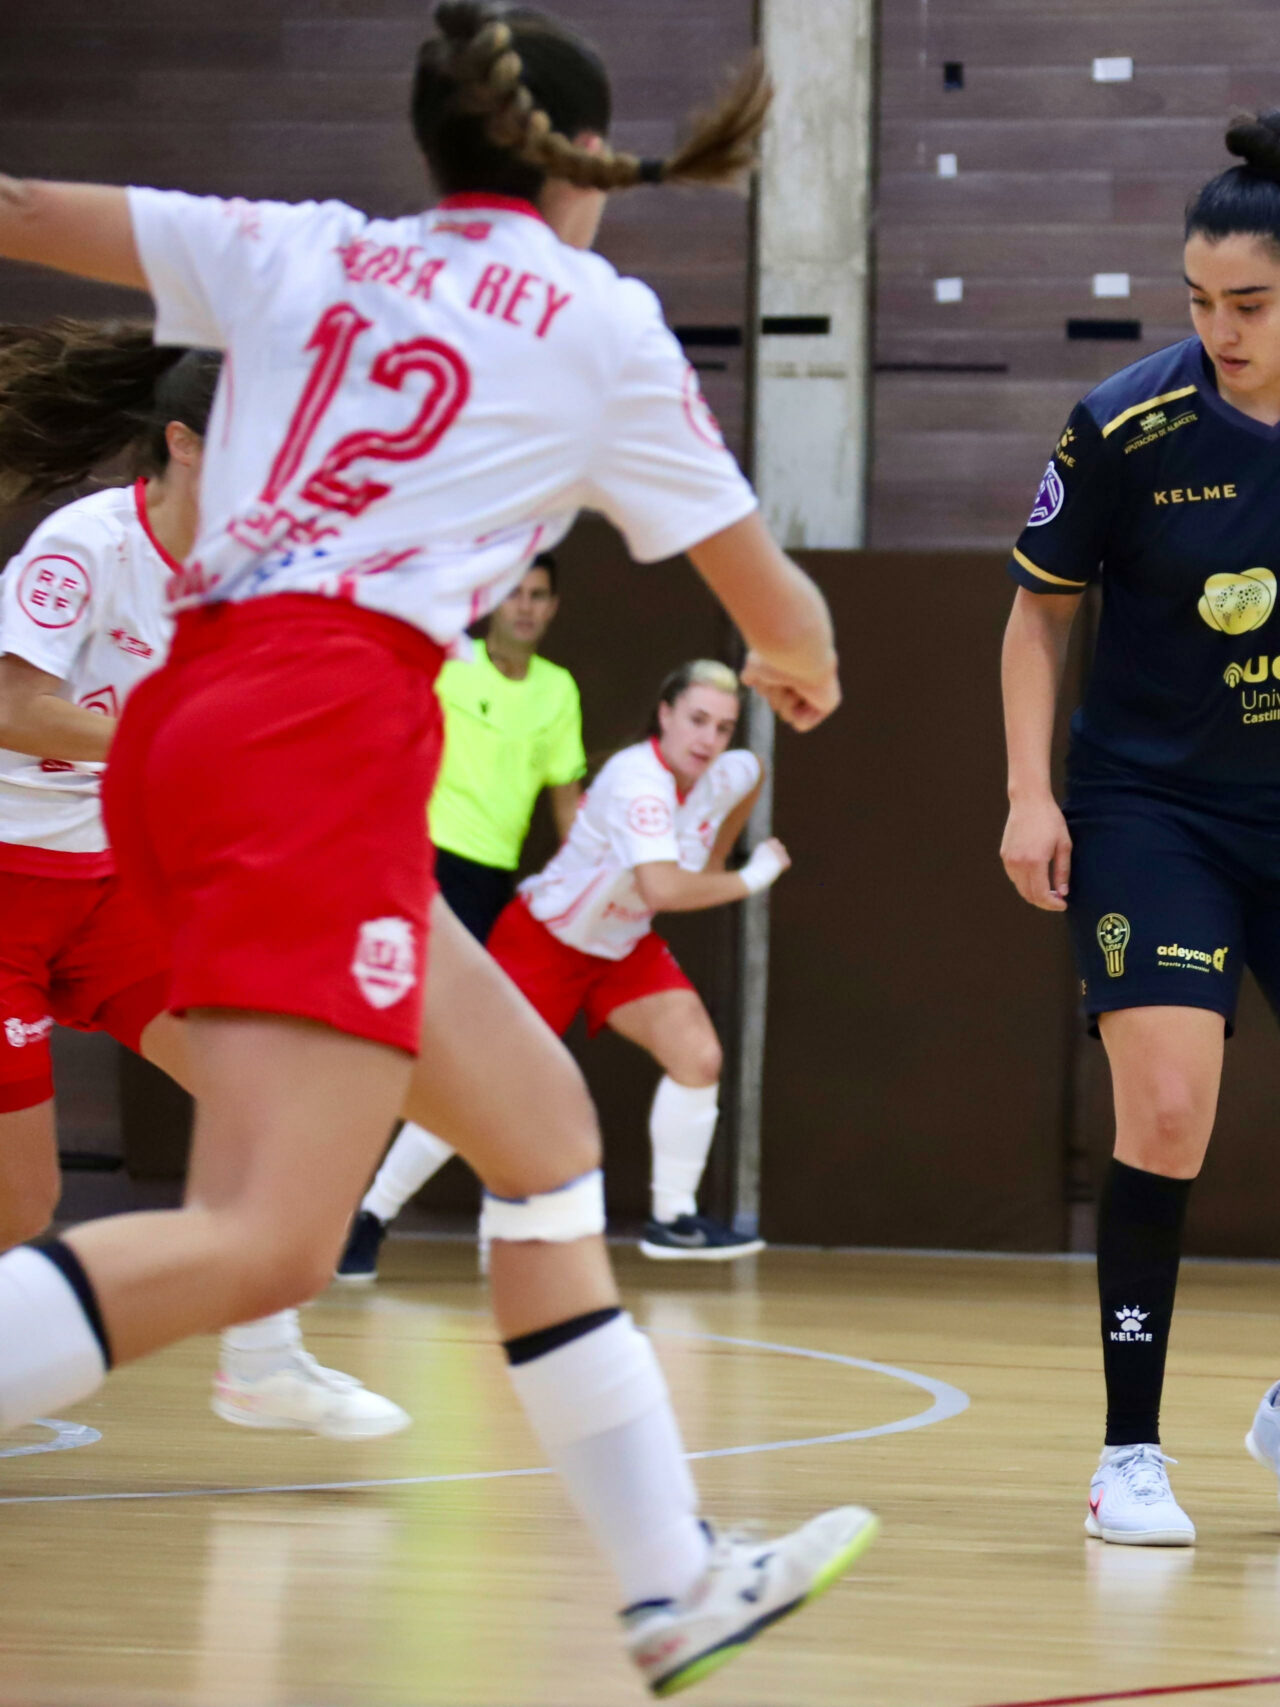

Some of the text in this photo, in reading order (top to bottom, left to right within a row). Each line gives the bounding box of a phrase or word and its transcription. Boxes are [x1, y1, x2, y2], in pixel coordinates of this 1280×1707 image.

[468, 263, 573, 338] REY
[257, 301, 472, 517] 12
[1153, 484, 1237, 505] KELME
[1156, 943, 1213, 965] adeycap
[1110, 1330, 1153, 1342] KELME
